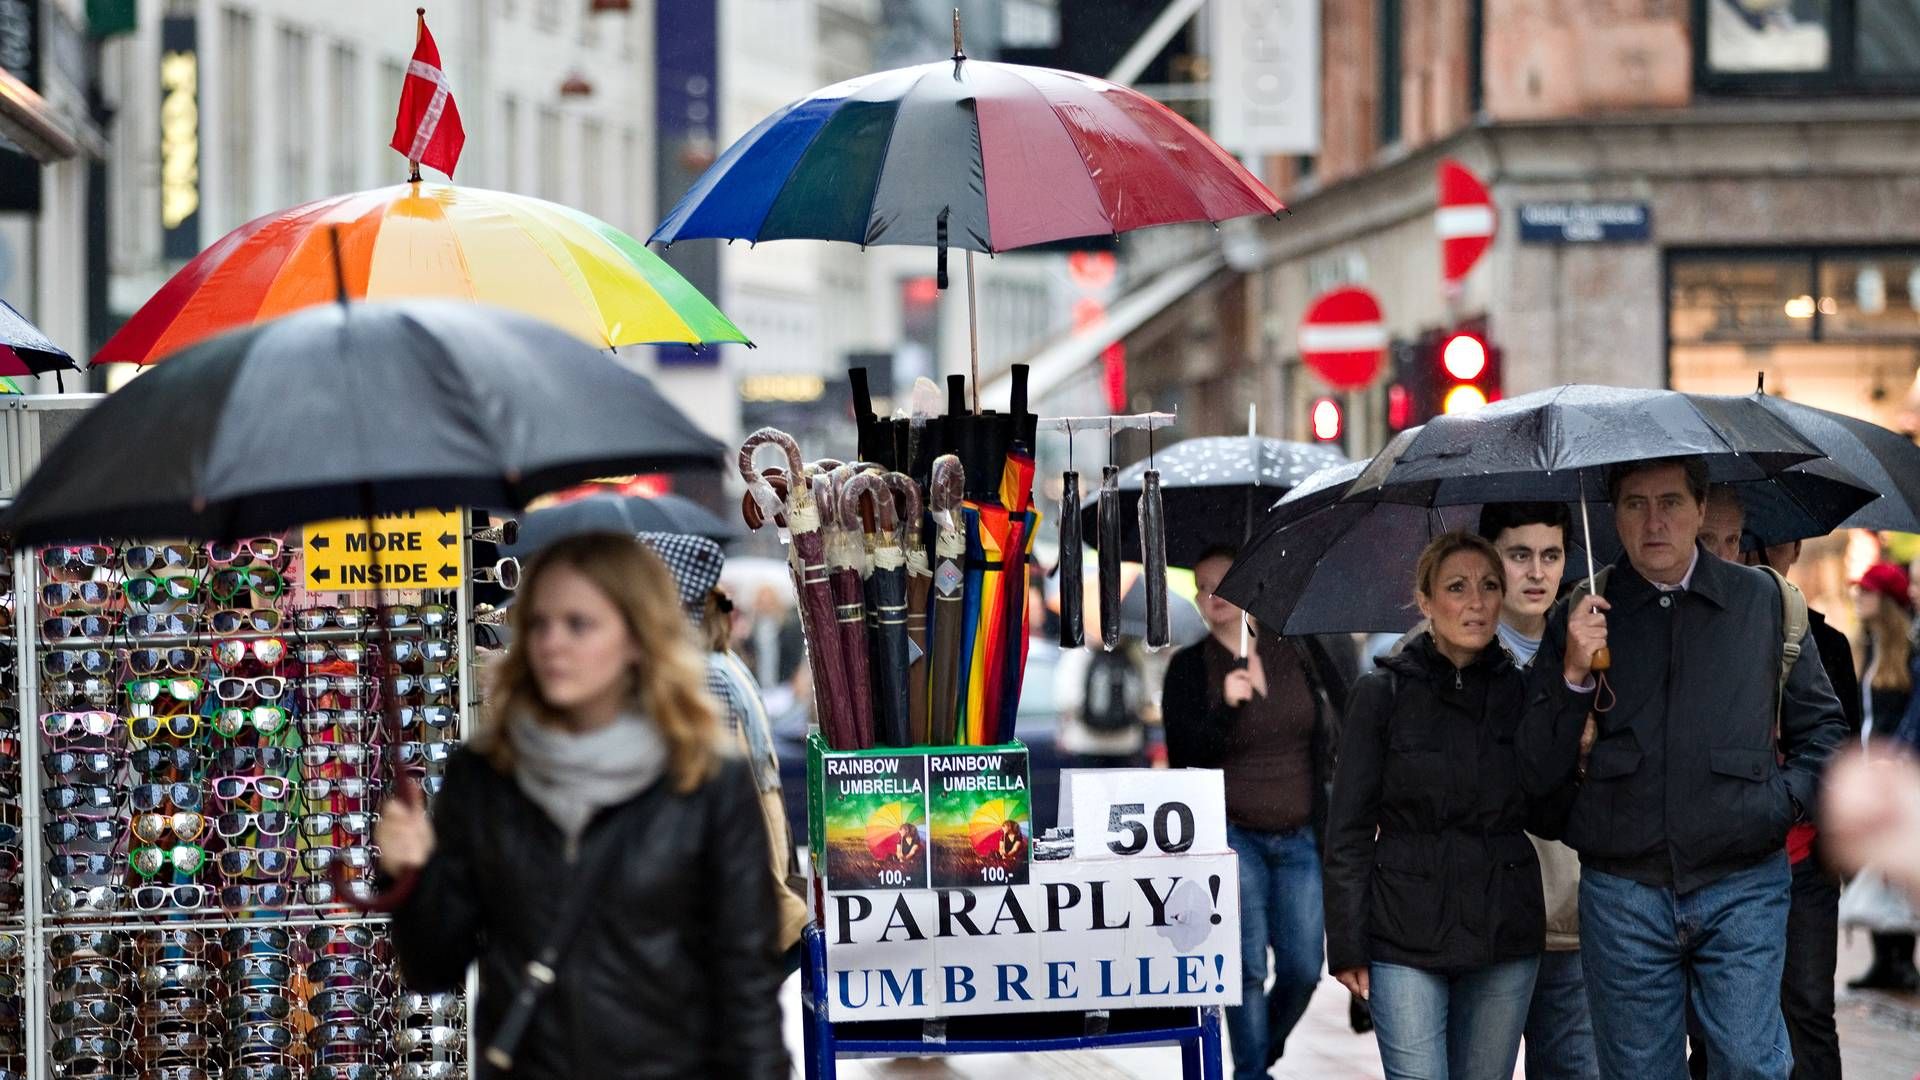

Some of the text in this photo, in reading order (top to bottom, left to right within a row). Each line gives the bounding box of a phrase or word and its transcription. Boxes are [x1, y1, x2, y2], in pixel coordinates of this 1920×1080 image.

[345, 531, 422, 552] MORE
[341, 563, 427, 584] INSIDE
[828, 758, 899, 775] RAINBOW
[931, 755, 1001, 772] RAINBOW
[840, 778, 922, 795] UMBRELLA
[943, 775, 1025, 792] UMBRELLA
[1106, 801, 1195, 856] 50
[878, 870, 911, 887] 100,-
[981, 867, 1013, 884] 100,-
